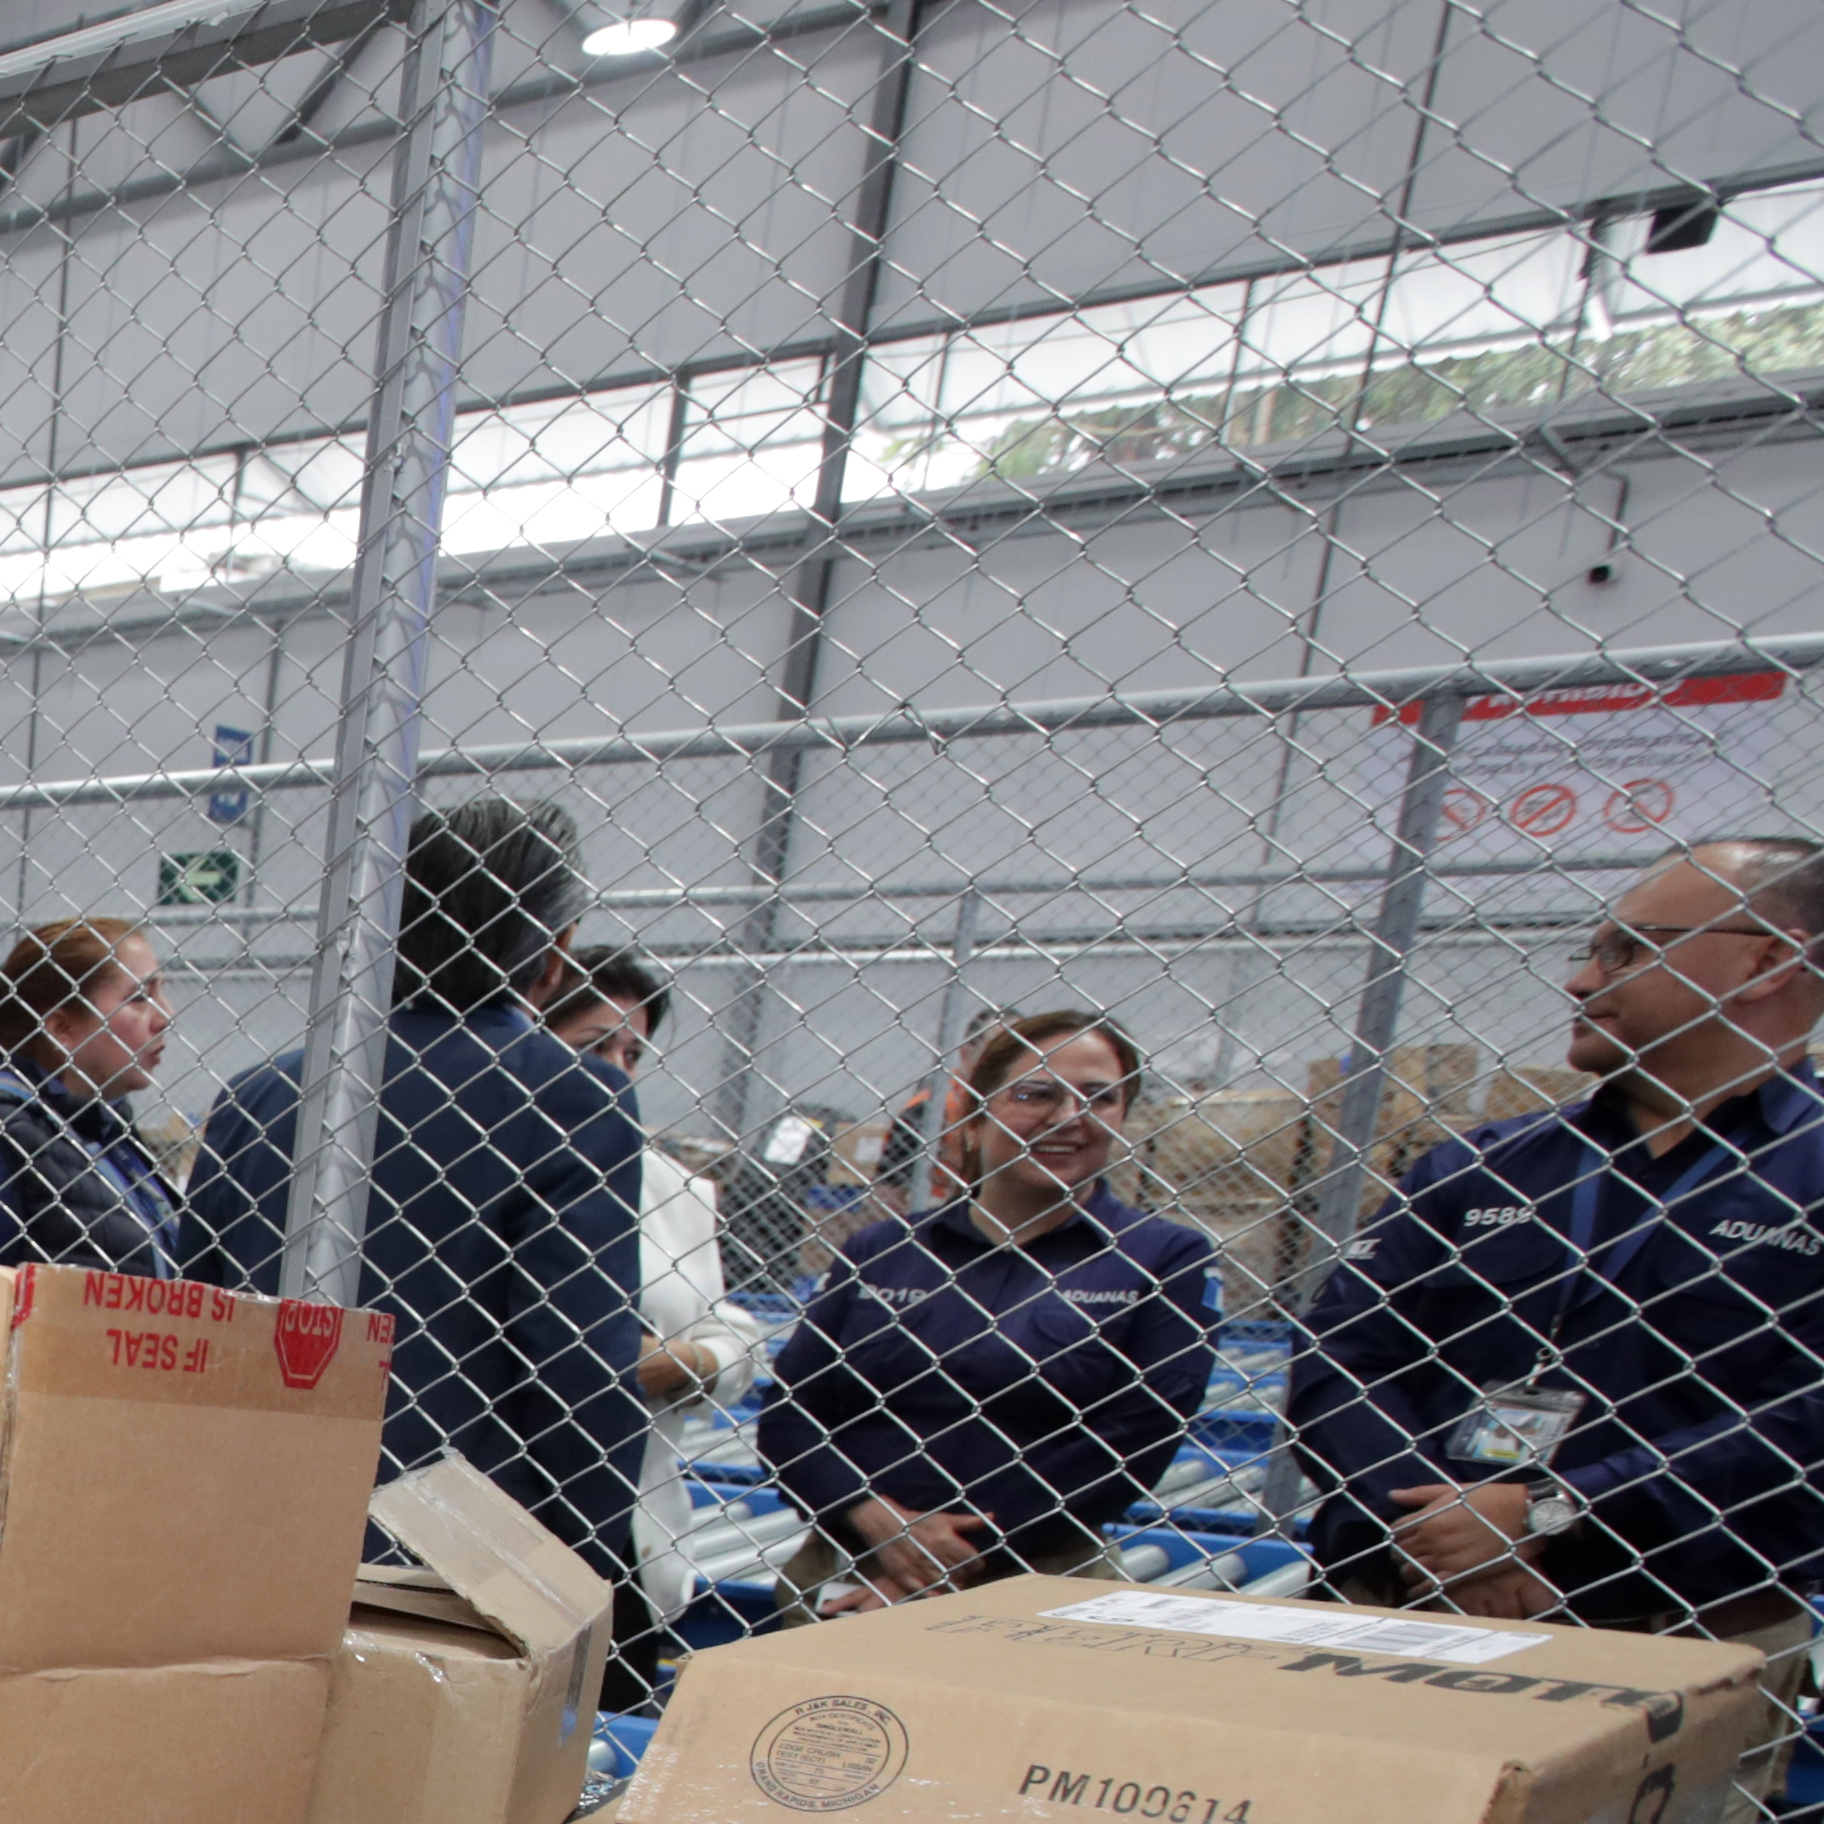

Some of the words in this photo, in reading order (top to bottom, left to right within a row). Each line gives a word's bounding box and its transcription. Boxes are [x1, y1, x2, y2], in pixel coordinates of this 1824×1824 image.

[1710, 1219, 1821, 1256] ADUANAS
[84, 1270, 204, 1319] BROKEN
[211, 1289, 235, 1324] IS
[1062, 1289, 1138, 1304] ADUANAS
[284, 1302, 337, 1337] STOP
[106, 1328, 179, 1370] SEAL
[184, 1338, 208, 1374] IF
[808, 1699, 829, 1711] J&K
[832, 1699, 868, 1713] SALES
[775, 1750, 799, 1762] TEST
[779, 1741, 804, 1756] EDGE
[807, 1746, 840, 1760] CRUSH
[821, 1782, 882, 1810] MICHIGAN
